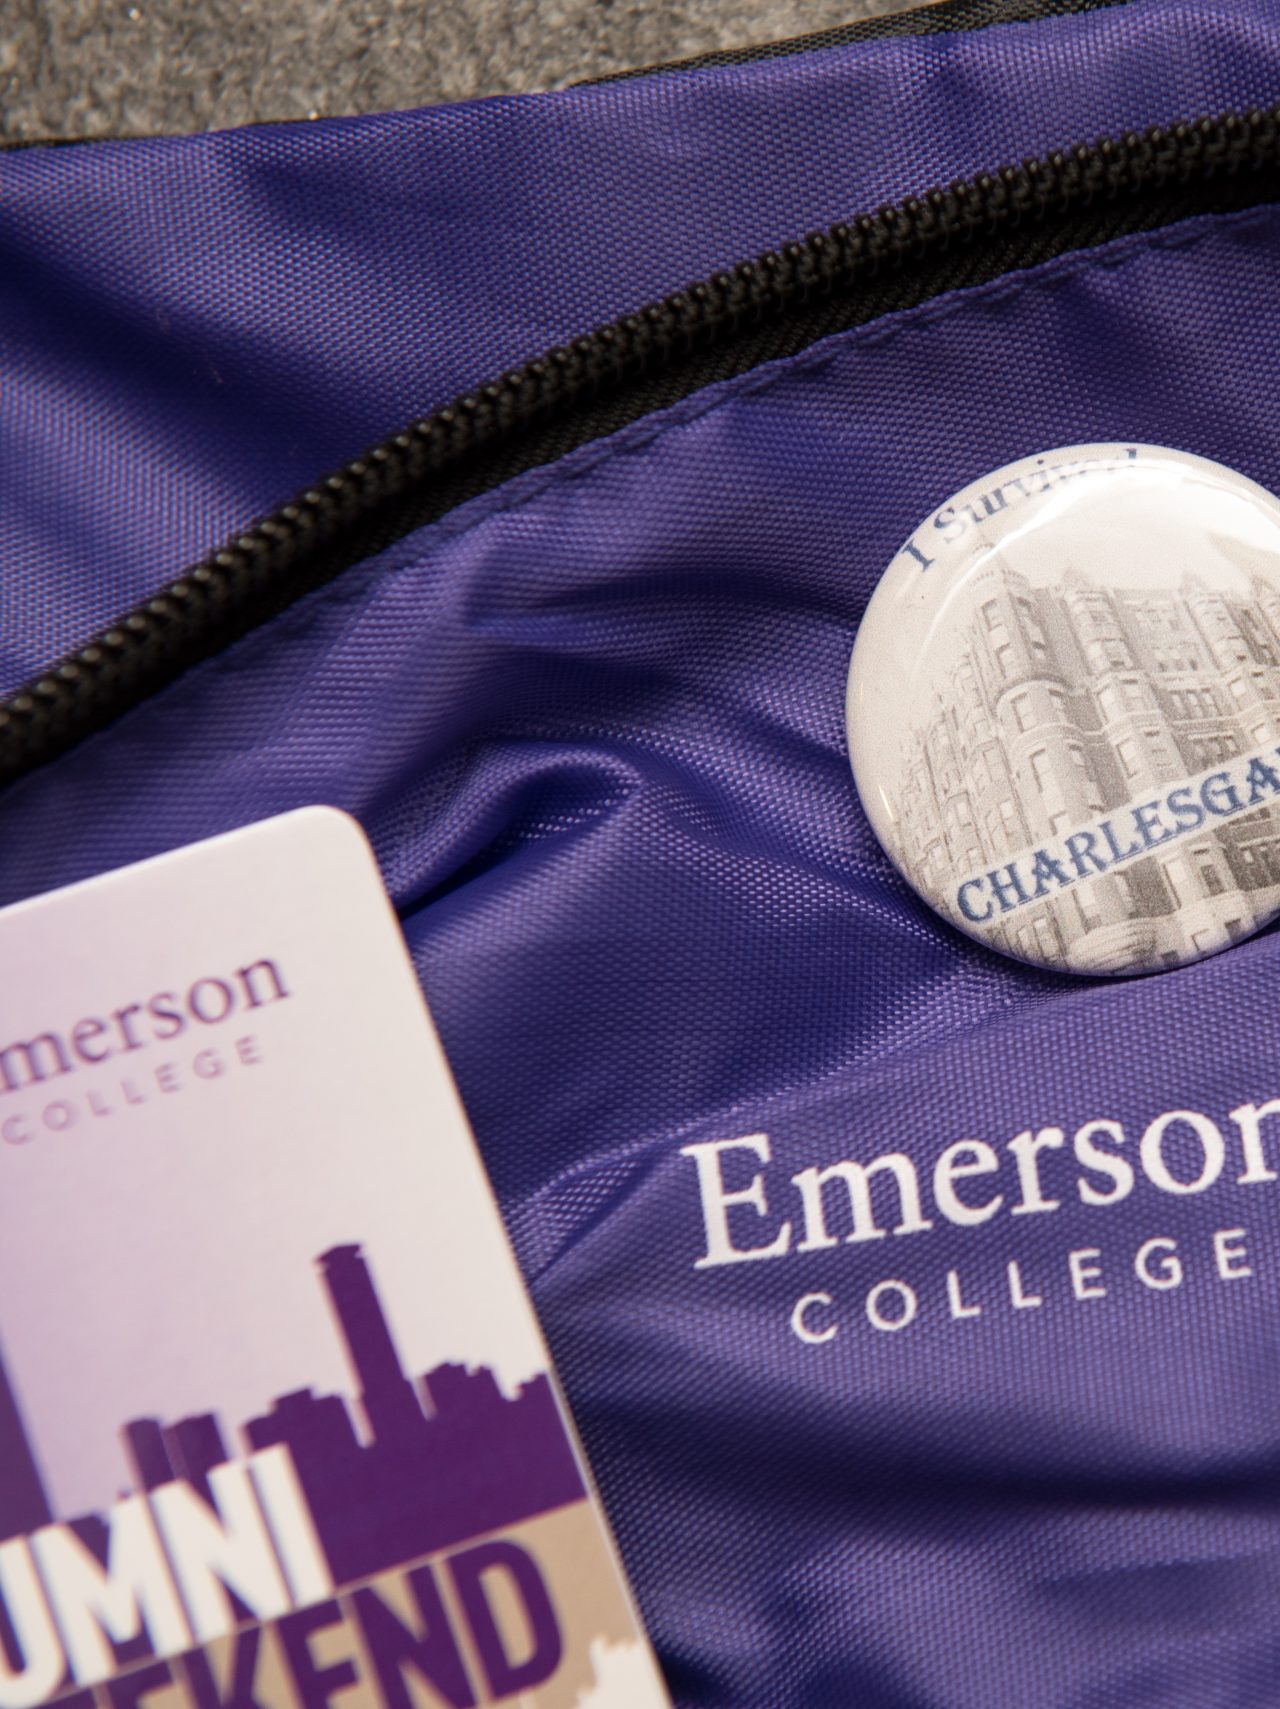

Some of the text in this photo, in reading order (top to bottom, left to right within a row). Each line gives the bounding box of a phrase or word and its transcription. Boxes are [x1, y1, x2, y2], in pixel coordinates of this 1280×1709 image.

[901, 539, 935, 573] I
[0, 1035, 263, 1146] COLLEGE
[790, 1229, 1252, 1344] COLLEGE
